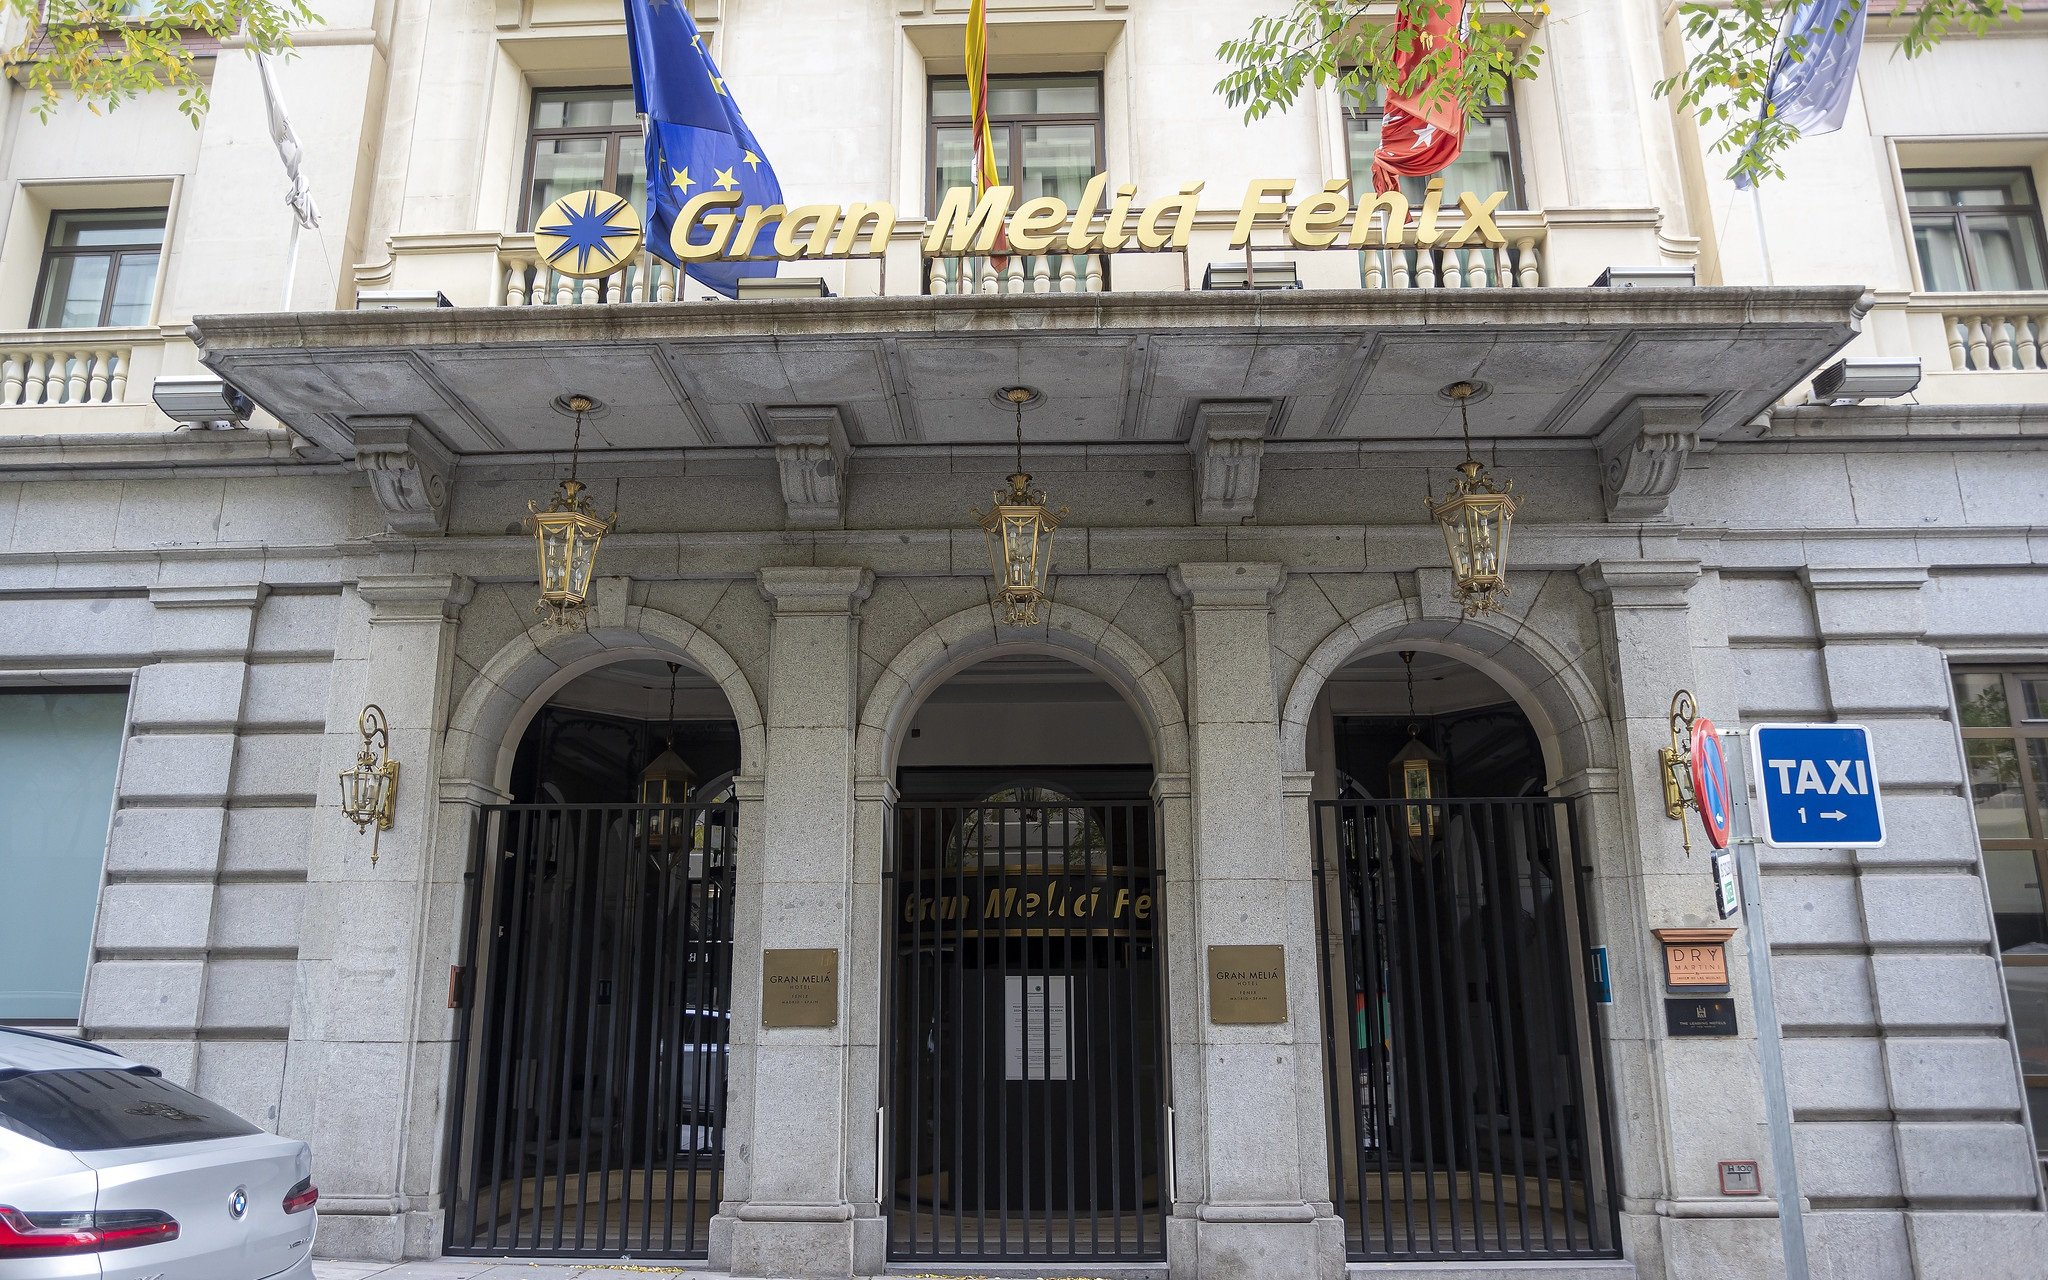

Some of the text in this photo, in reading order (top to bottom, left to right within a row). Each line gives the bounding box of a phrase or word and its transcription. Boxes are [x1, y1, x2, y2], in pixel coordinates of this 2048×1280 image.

[669, 171, 1509, 262] Gran Meliá Fénix
[1768, 759, 1869, 795] TAXI
[1797, 807, 1808, 824] 1
[1673, 948, 1718, 962] DRY
[770, 971, 831, 984] GRAN MELIÁ
[1216, 967, 1279, 980] GRAN MELIÁ
